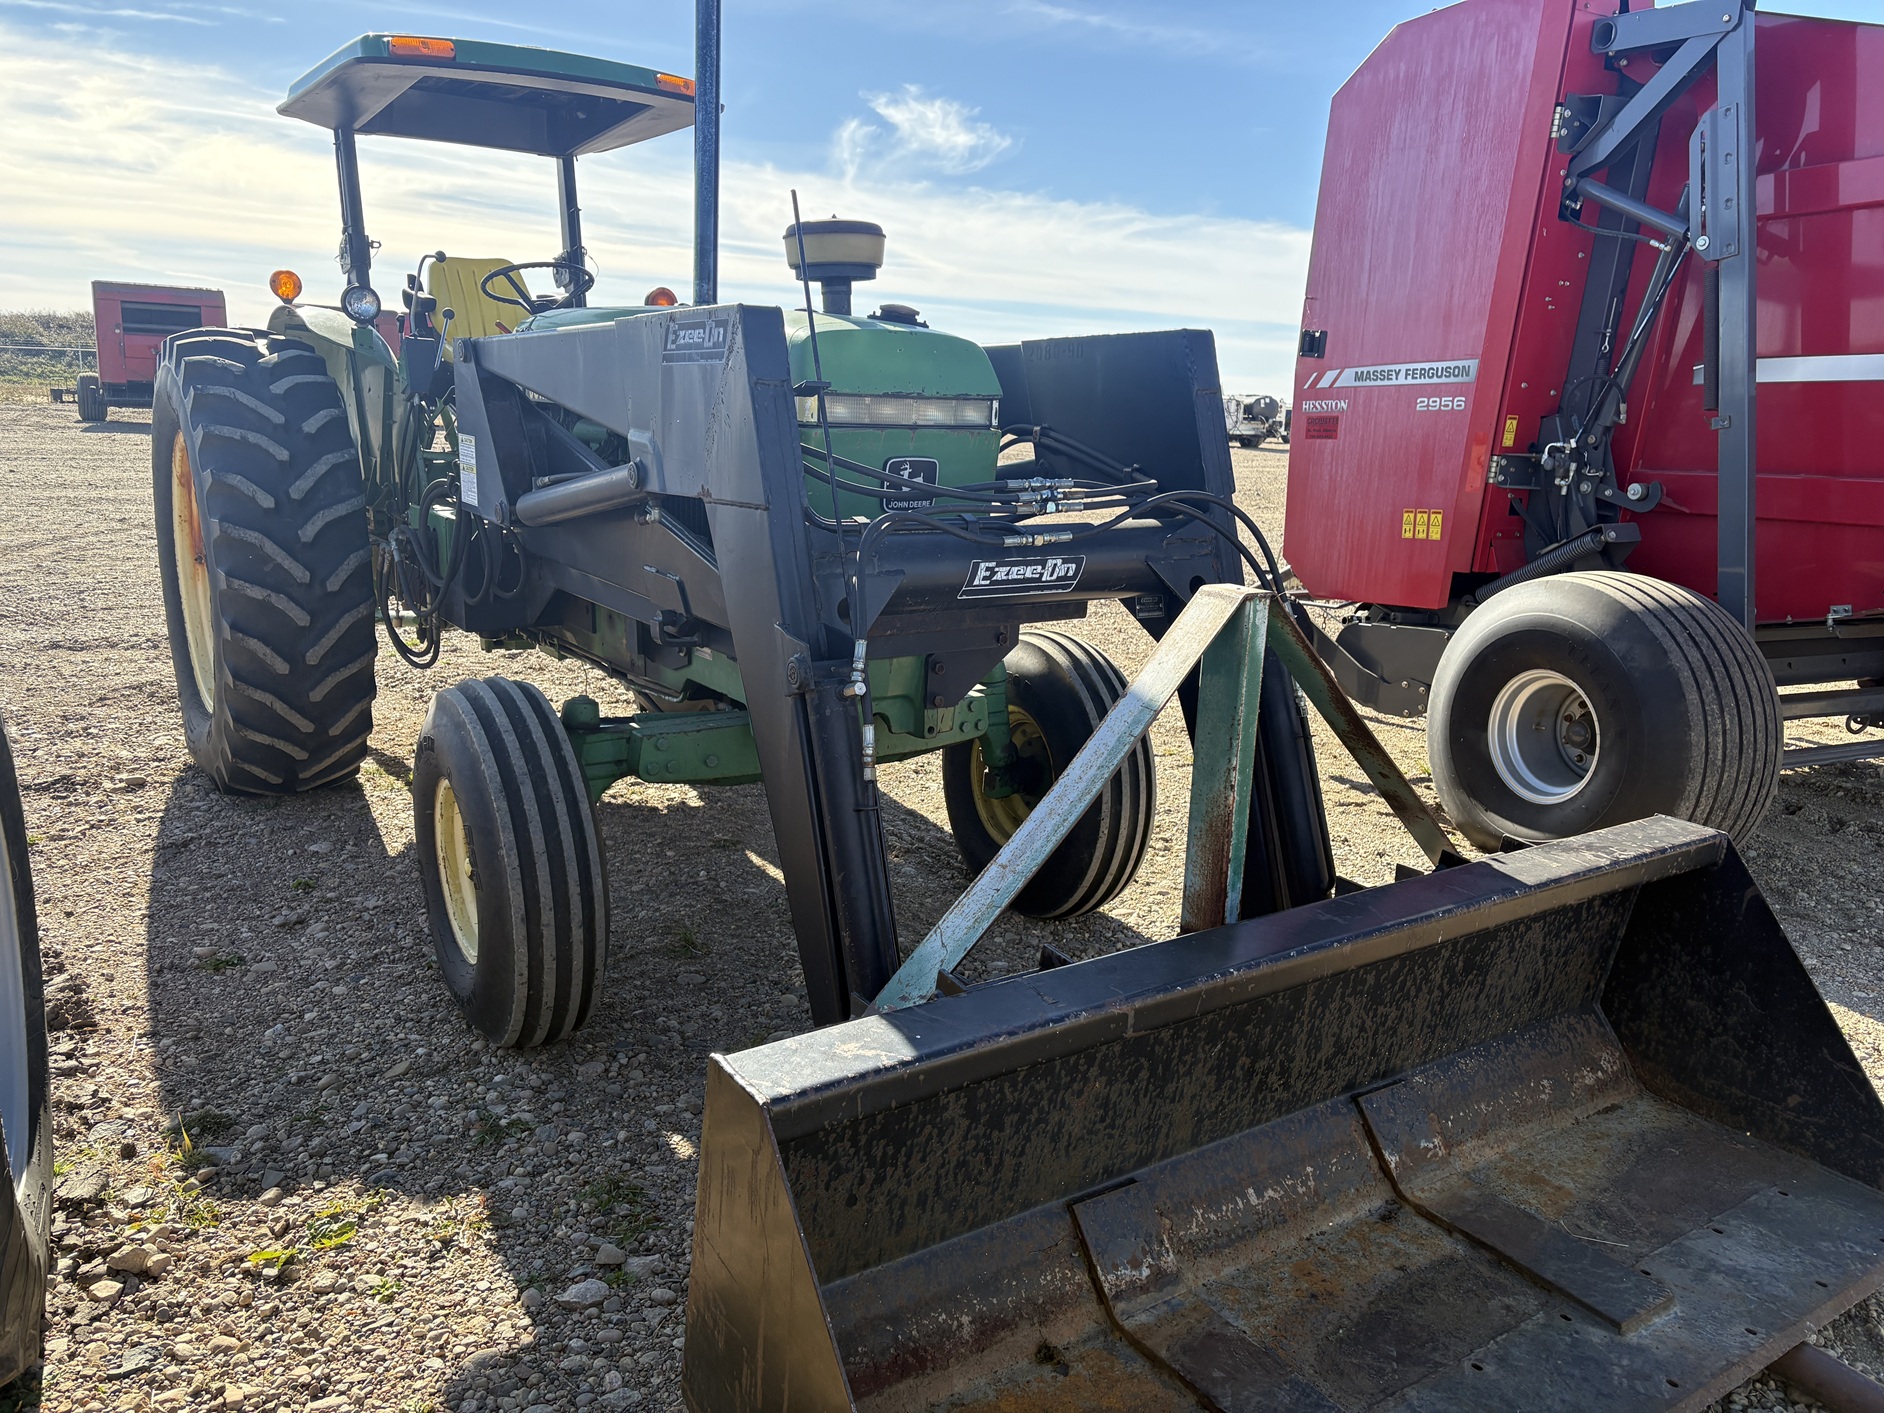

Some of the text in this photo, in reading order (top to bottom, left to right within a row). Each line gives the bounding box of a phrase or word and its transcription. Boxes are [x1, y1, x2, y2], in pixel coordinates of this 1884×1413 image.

[1354, 365, 1471, 383] MASSEY FERGUSON
[1302, 399, 1349, 412] HESSTON
[1416, 397, 1466, 411] 2956
[909, 500, 931, 508] DEERE
